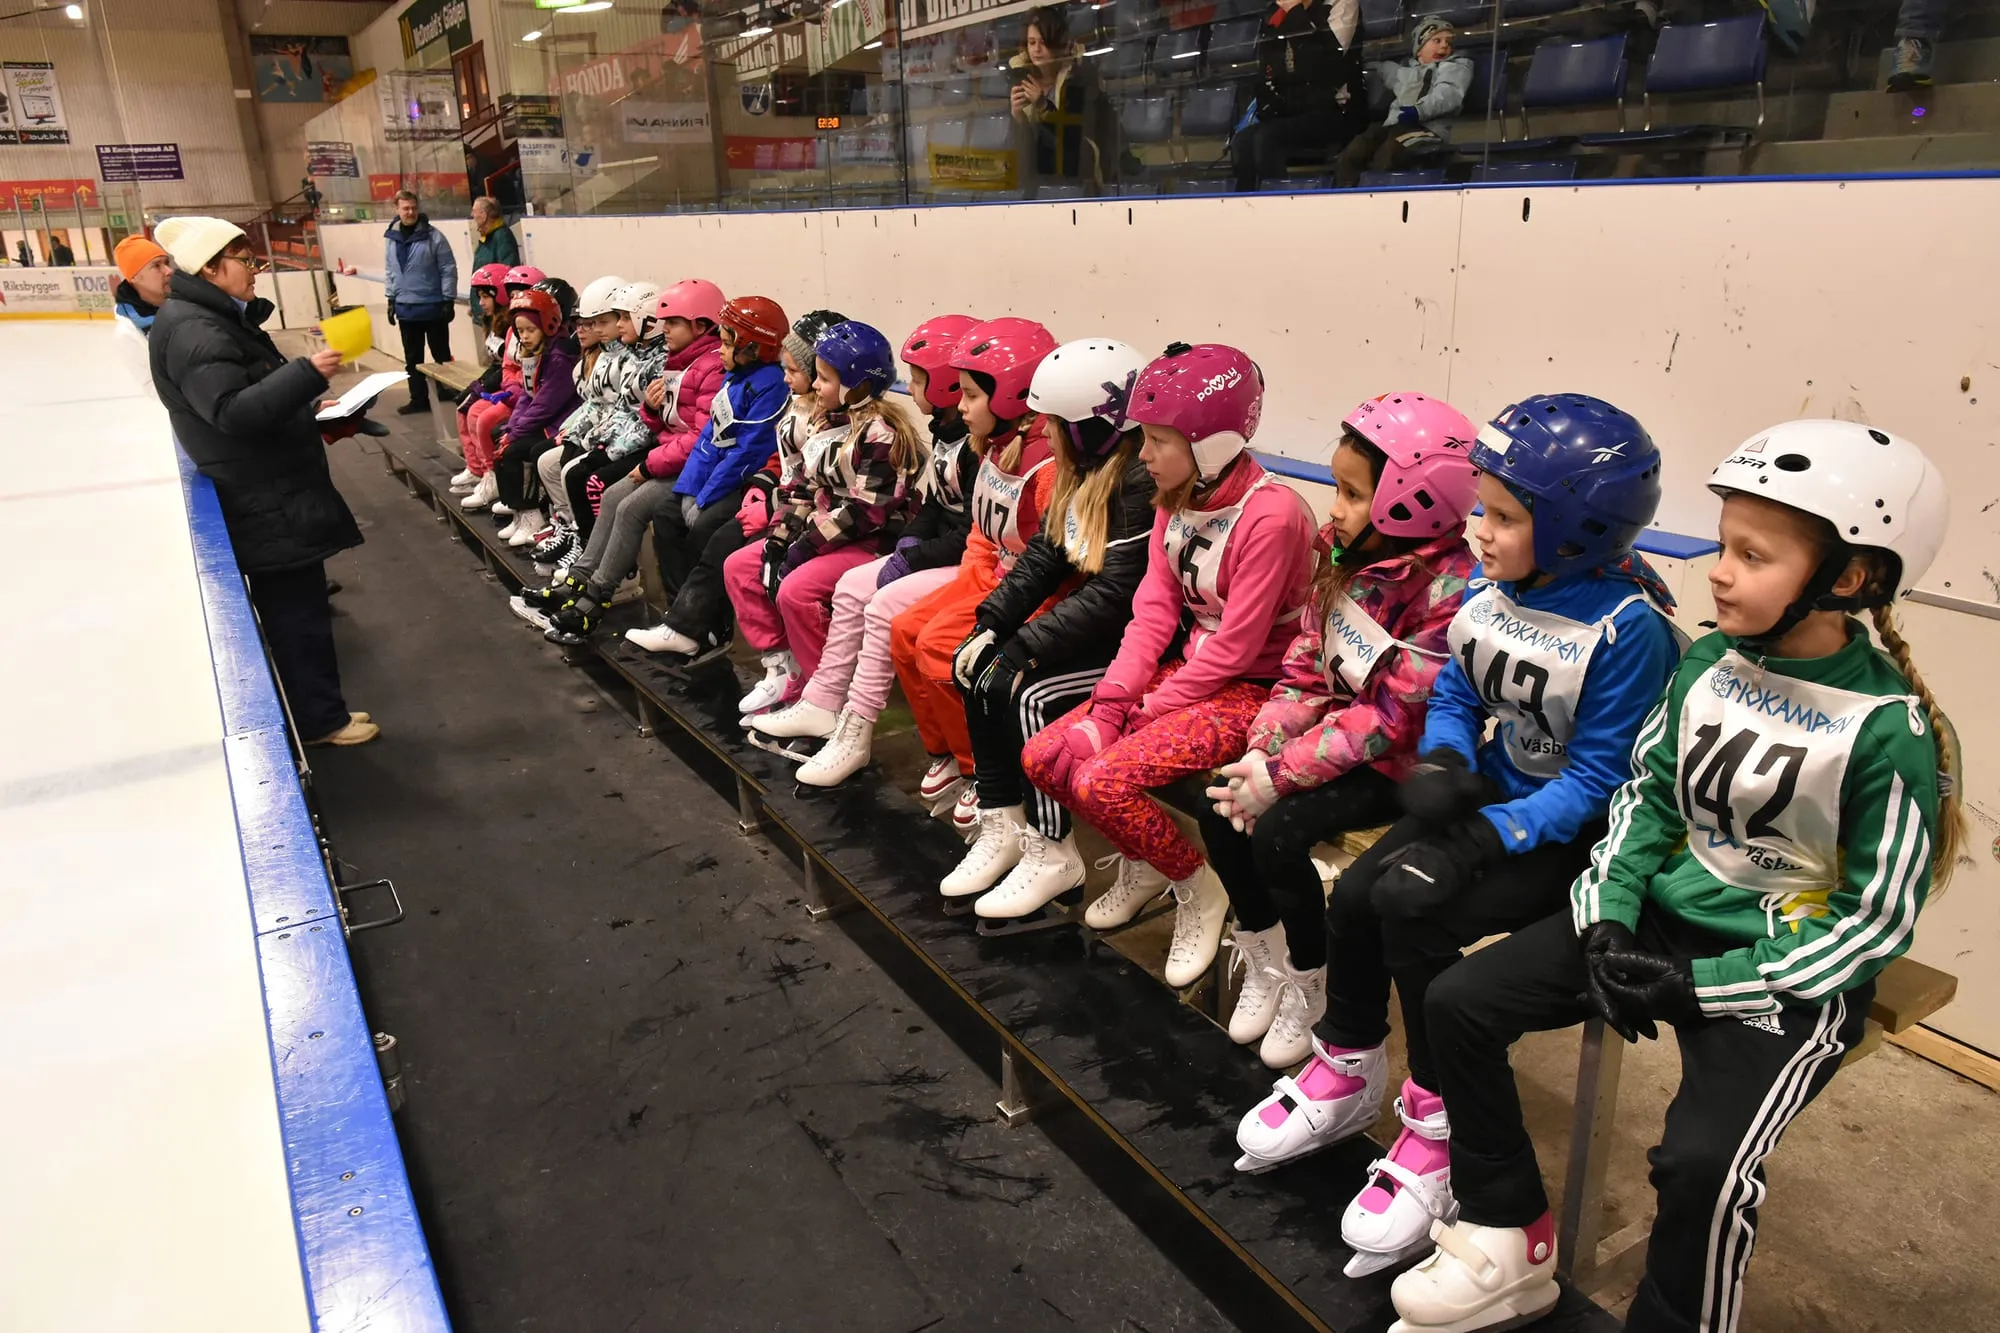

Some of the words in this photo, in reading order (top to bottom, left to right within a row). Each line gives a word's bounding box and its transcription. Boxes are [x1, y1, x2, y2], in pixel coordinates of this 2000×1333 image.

[566, 58, 625, 96] HONDA
[3, 280, 60, 294] Riksbyggen
[73, 275, 108, 292] nova
[1490, 611, 1586, 665] TIOKAMPEN
[1461, 637, 1555, 741] 143
[1725, 676, 1856, 736] TIOKAMPEN
[1681, 722, 1809, 846] 142
[1742, 1019, 1786, 1036] adidas
